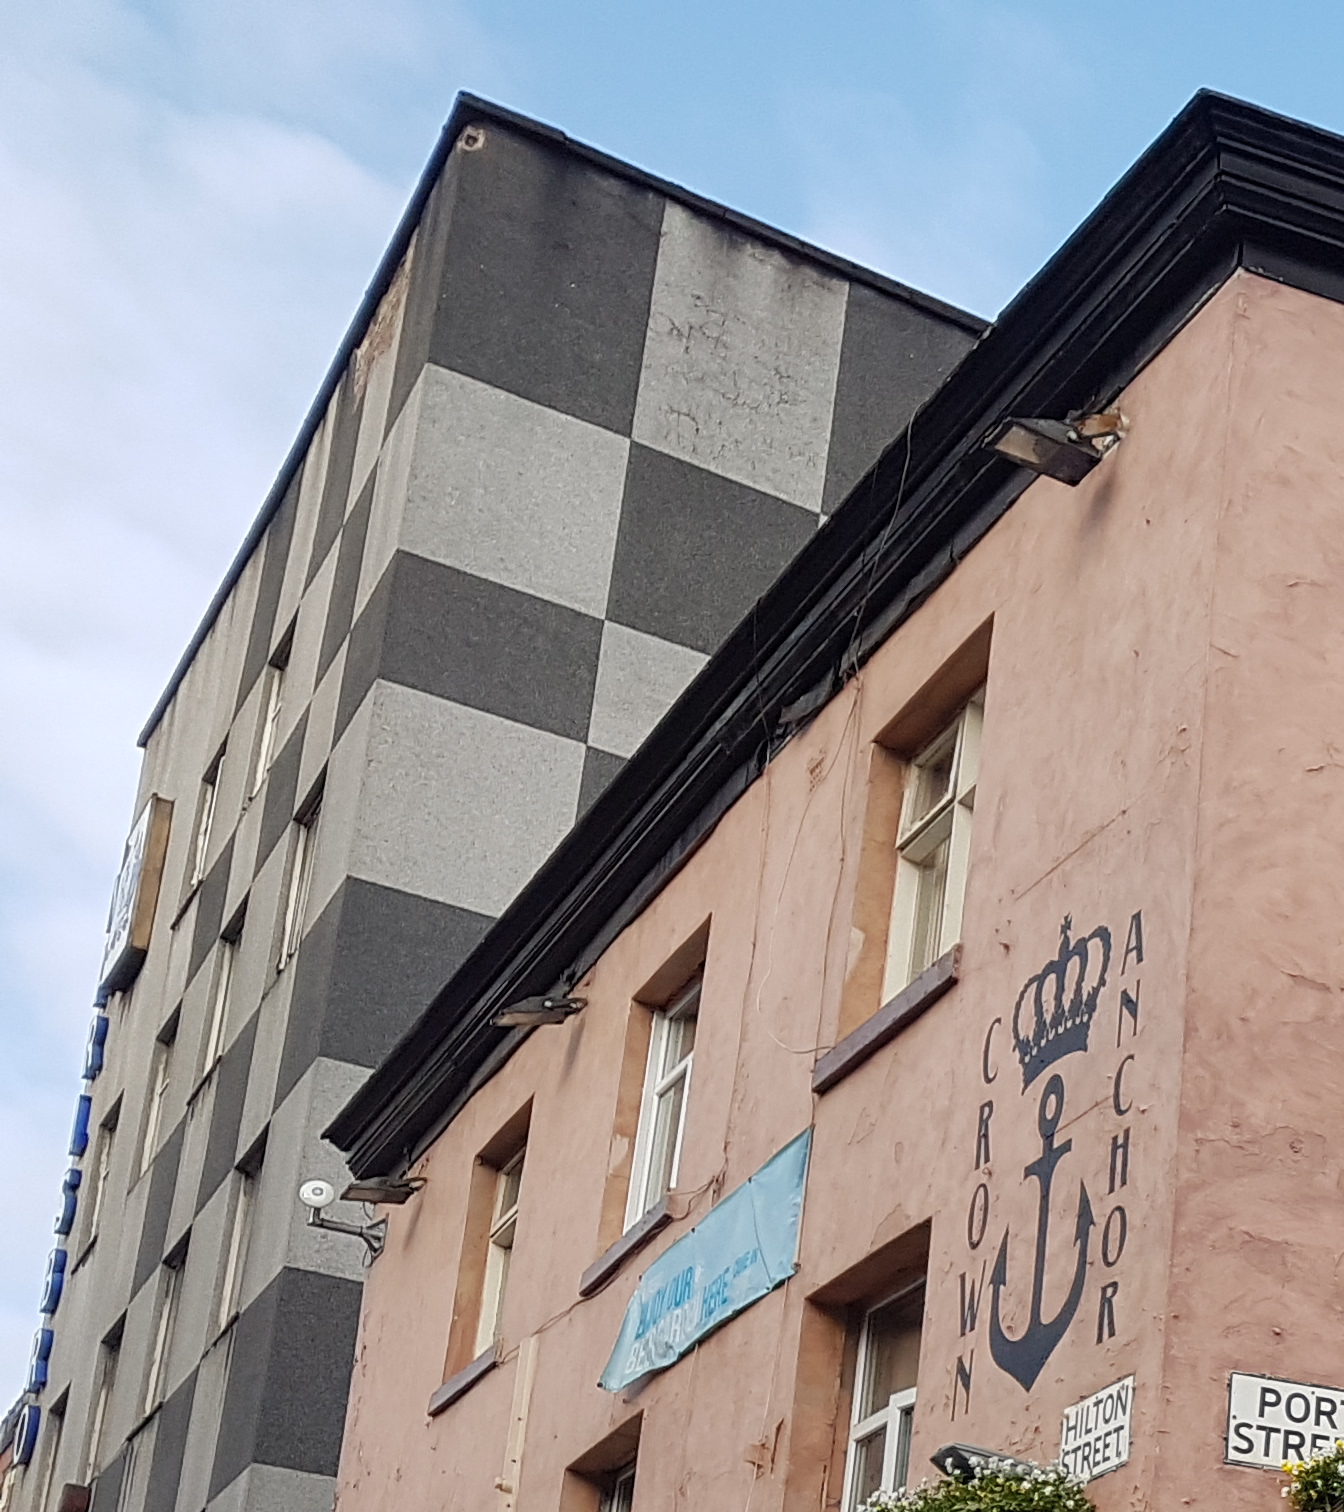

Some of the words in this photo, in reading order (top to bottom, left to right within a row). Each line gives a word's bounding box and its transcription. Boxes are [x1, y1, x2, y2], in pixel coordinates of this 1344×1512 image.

[951, 1016, 1003, 1422] CROWN
[1096, 908, 1144, 1346] ANCHOR
[1061, 1424, 1125, 1479] STREET
[1064, 1384, 1129, 1446] HILTON
